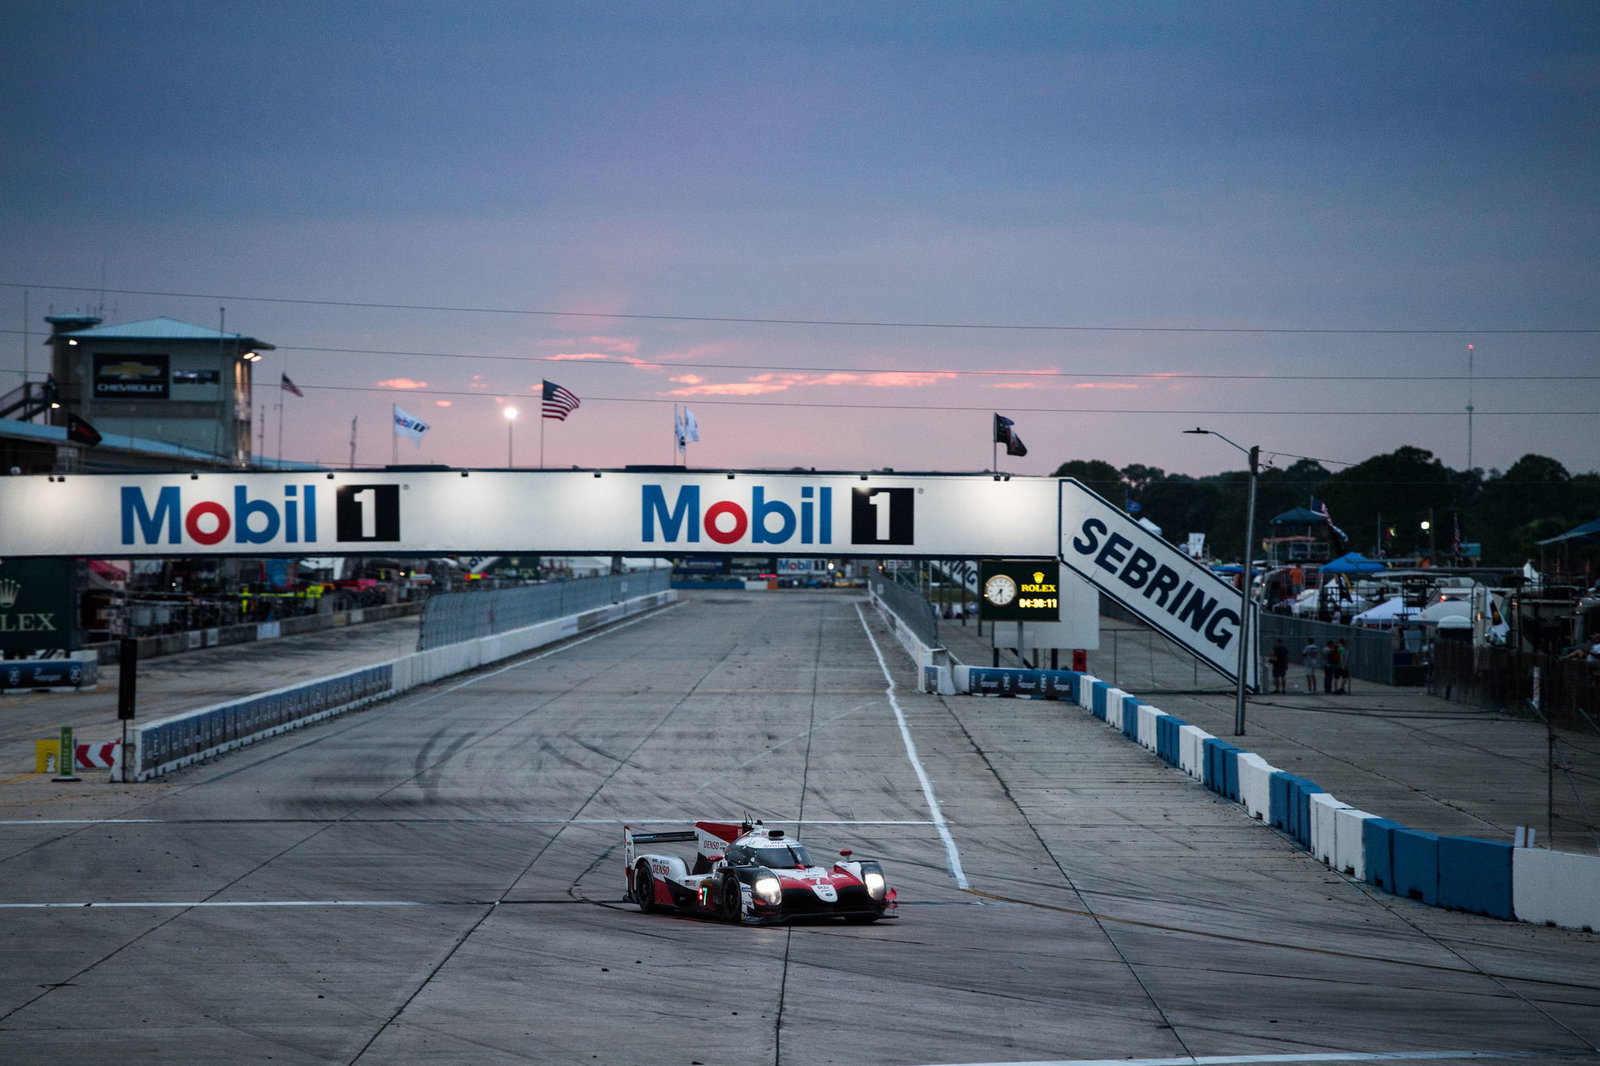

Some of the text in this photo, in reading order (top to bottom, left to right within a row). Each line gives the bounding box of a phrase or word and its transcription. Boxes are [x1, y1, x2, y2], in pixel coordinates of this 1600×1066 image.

[97, 383, 163, 392] CHEVROLET
[121, 485, 317, 545] Mobil
[642, 485, 832, 544] Mobil
[1021, 584, 1057, 592] ROLEX
[1073, 518, 1241, 650] SEBRING
[704, 840, 720, 850] DENSO
[653, 864, 670, 876] DENSO
[702, 887, 708, 906] 7
